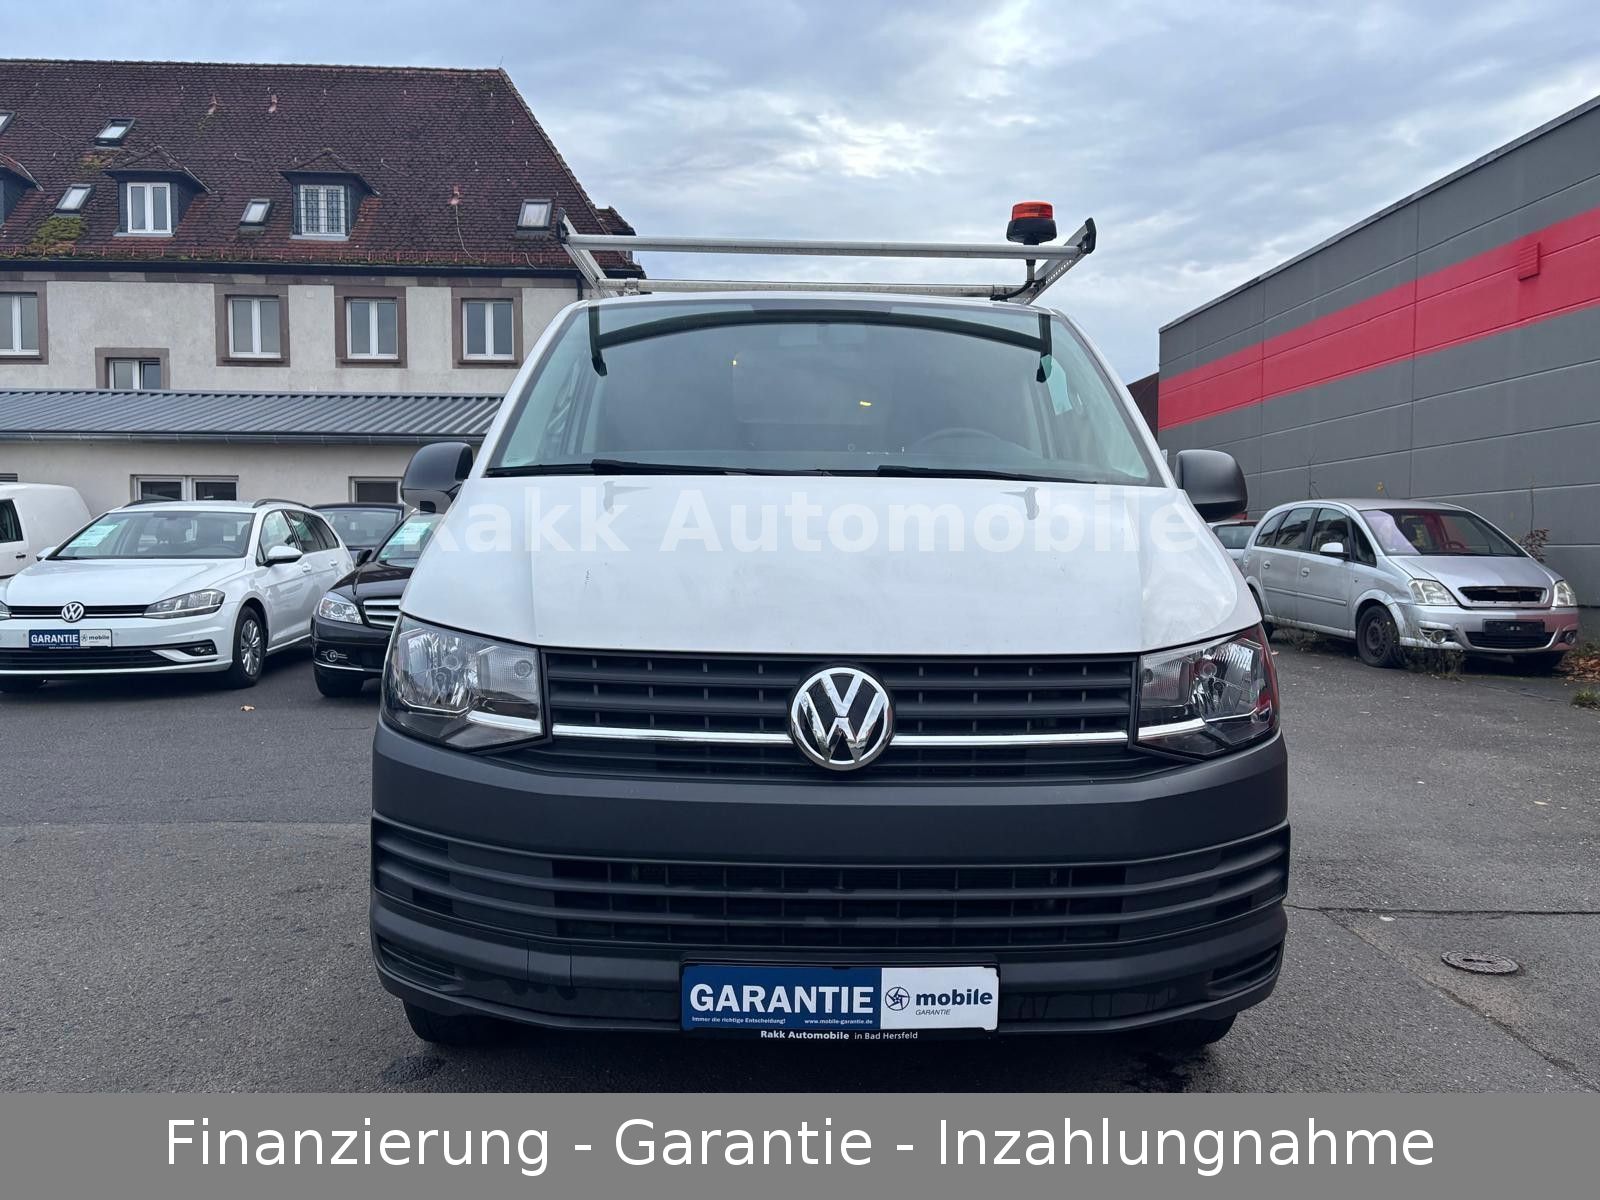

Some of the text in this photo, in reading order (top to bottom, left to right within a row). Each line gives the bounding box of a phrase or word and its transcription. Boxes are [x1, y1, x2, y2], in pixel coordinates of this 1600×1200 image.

[31, 634, 79, 643] GARANTIE
[690, 983, 874, 1014] GARANTIE
[915, 988, 993, 1006] mobile
[721, 1017, 744, 1025] richtige
[760, 1030, 918, 1040] Rakk Automobile in Bad Hersfeld
